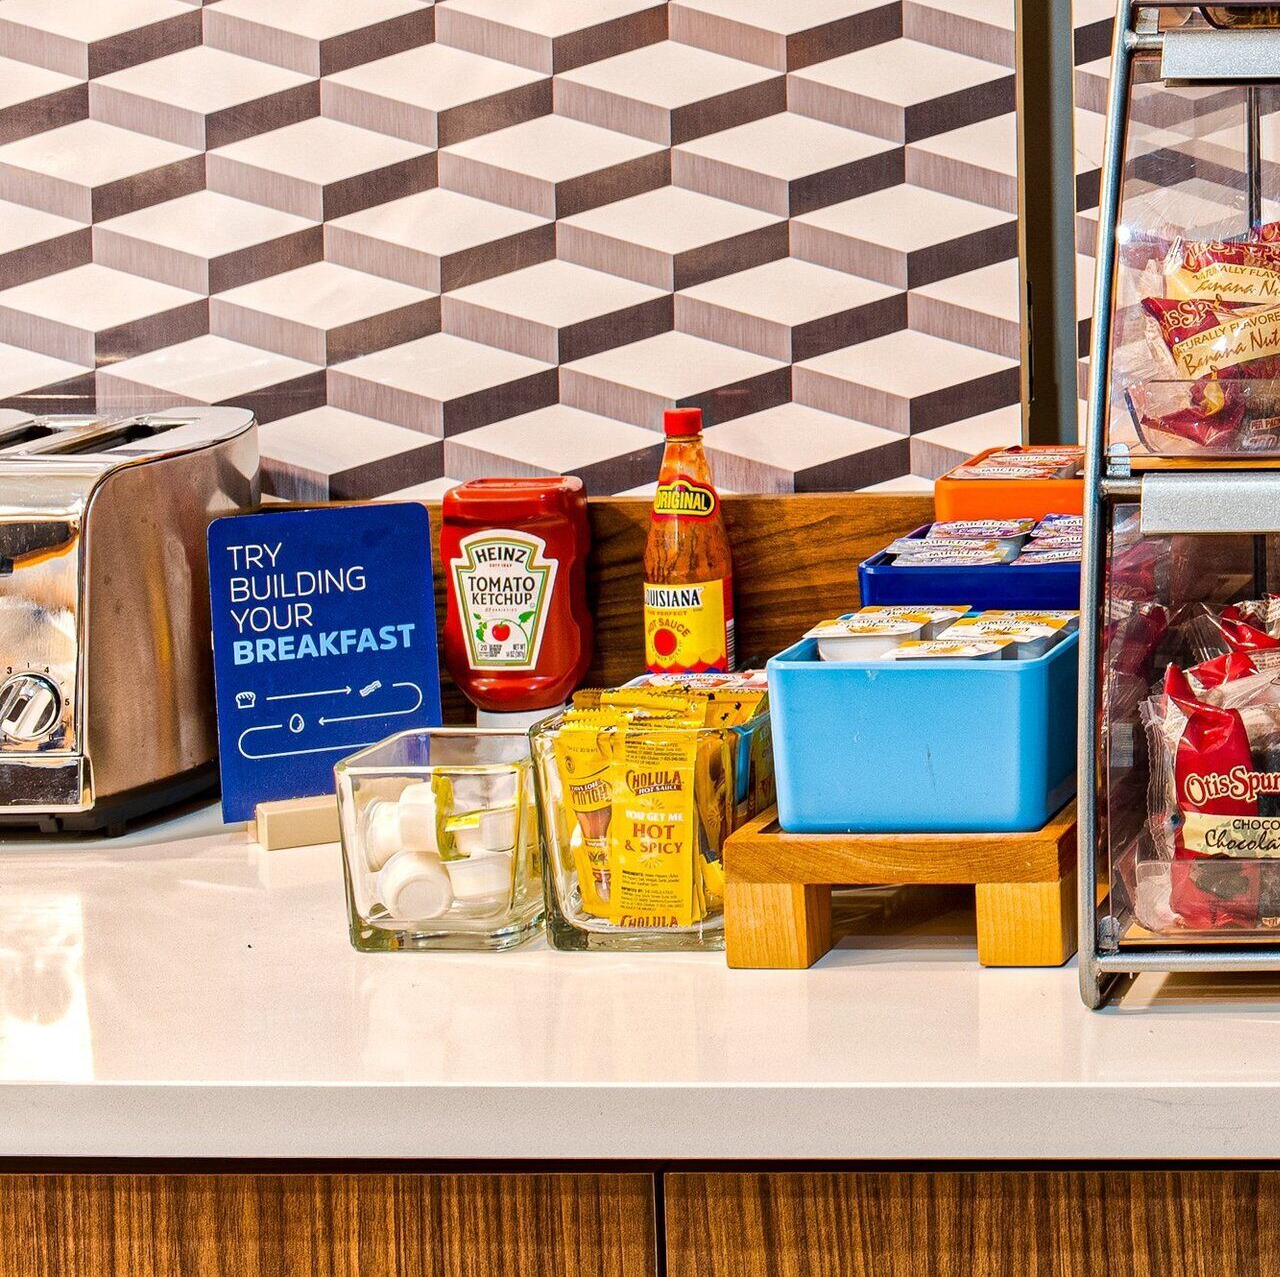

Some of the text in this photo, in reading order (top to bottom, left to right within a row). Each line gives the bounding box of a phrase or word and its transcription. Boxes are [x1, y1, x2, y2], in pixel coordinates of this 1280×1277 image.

[226, 542, 283, 573] TRY
[474, 546, 528, 565] HEINZ
[229, 565, 367, 603] BUILDING
[467, 576, 536, 592] TOMATO
[472, 592, 533, 606] KETCHUP
[643, 587, 702, 608] OUISIANA
[230, 602, 314, 635] YOUR
[657, 617, 692, 638] SAUCE
[232, 623, 417, 667] BREAKFAST
[7, 666, 13, 675] 3
[44, 666, 50, 674] 4
[625, 769, 683, 795] CHOLULA
[638, 787, 655, 795] HOT
[1184, 772, 1231, 806] Otis
[625, 809, 684, 822] YOU GET ME
[632, 822, 676, 841] HOT
[624, 839, 684, 855] & SPICY
